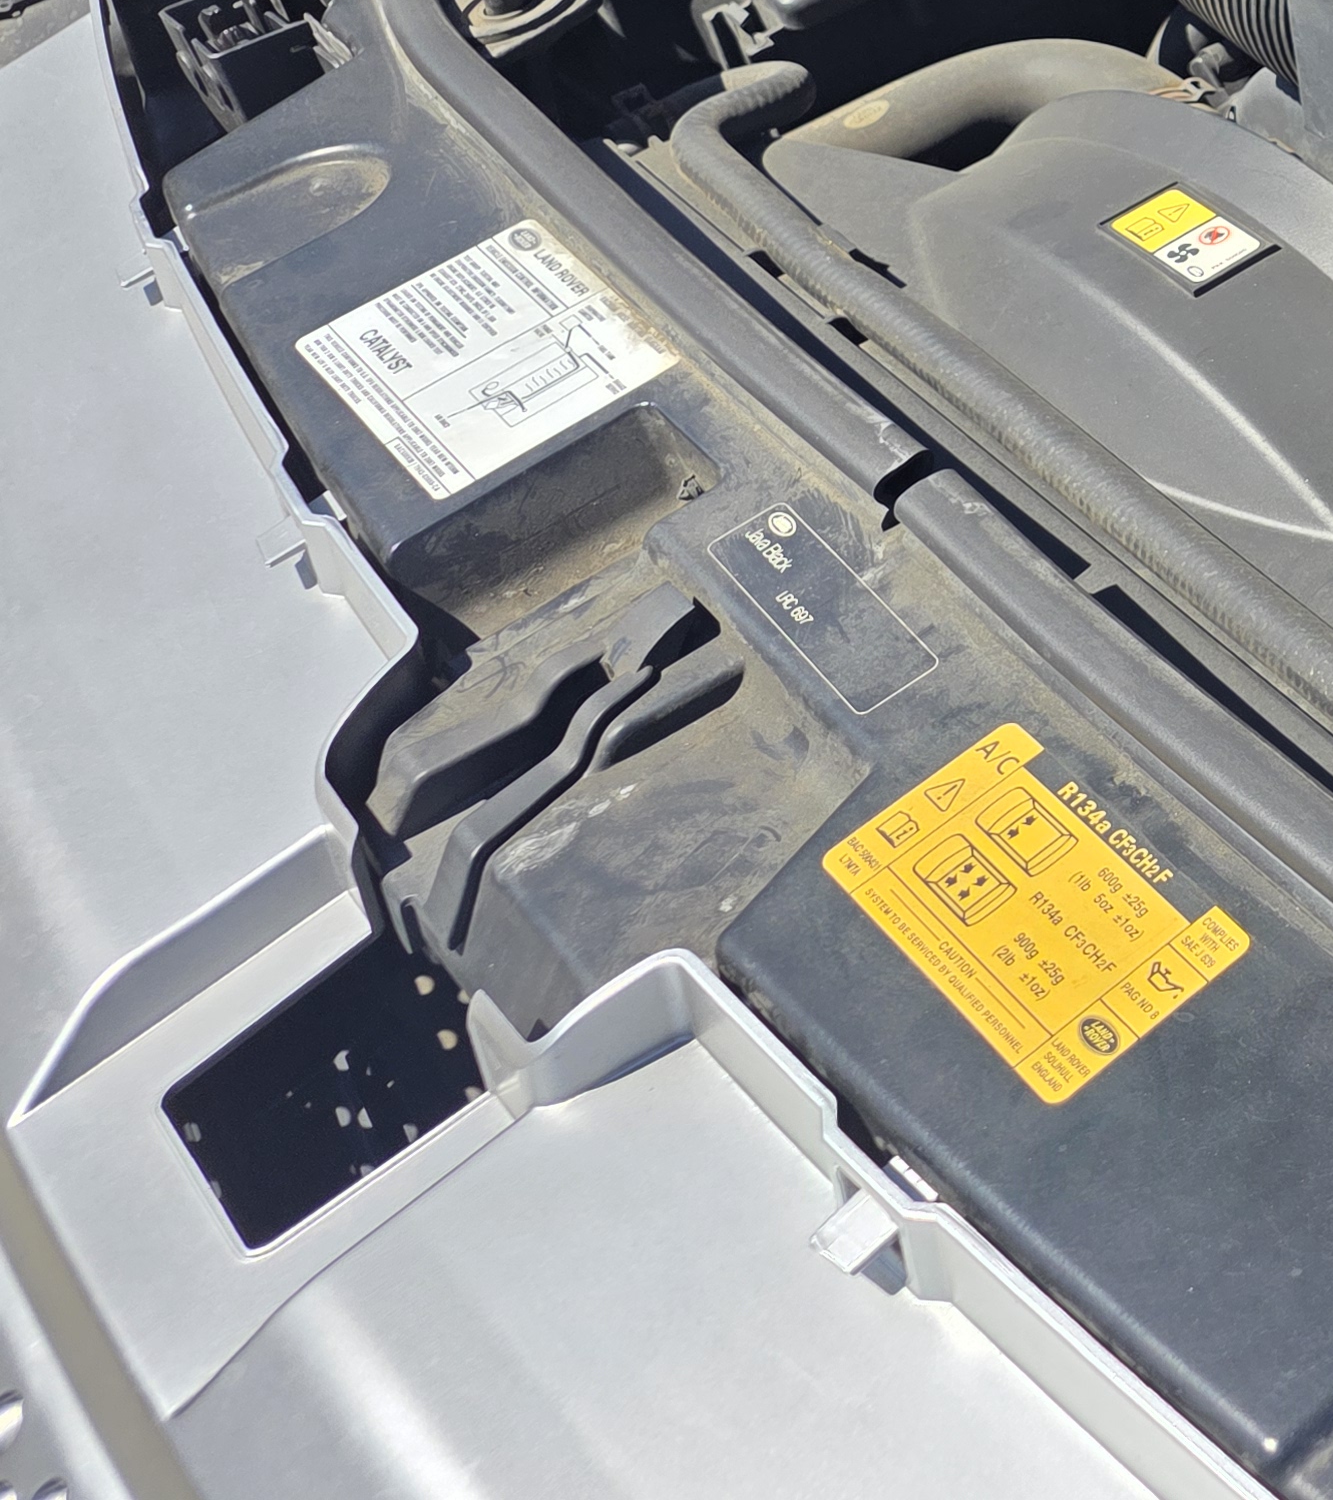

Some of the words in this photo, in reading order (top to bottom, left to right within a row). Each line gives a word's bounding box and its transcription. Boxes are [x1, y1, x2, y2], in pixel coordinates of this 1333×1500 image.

[532, 248, 564, 272] LAND
[554, 267, 590, 297] ROVER
[356, 327, 413, 376] CATALYST
[744, 528, 771, 551] Java
[762, 543, 792, 573] Black
[775, 590, 799, 611] LRC
[790, 604, 814, 625] 697
[974, 736, 1021, 775] A/C
[1057, 781, 1111, 833] R134a
[846, 836, 865, 852] BAC
[1027, 891, 1065, 926] R134a
[1066, 871, 1093, 894] (1lb
[1092, 893, 1115, 914] 5oz
[1108, 911, 1144, 943] ±1oz)
[1093, 867, 1125, 894] 600g
[1118, 890, 1150, 919] ±25g
[1179, 934, 1200, 952] SAE
[1199, 952, 1217, 968] 639
[1197, 932, 1220, 953] WITH
[1200, 916, 1240, 952] COMPLIES
[863, 887, 893, 915] SYSTEM
[887, 912, 902, 925] TO
[896, 921, 912, 935] BE
[906, 931, 942, 967] SERVICED
[937, 963, 952, 977] BY
[946, 974, 985, 1012] QUALIFIED
[979, 1009, 1025, 1054] PERSONNEL
[936, 940, 977, 979] CAUTION
[989, 943, 1018, 969] (2lb
[1015, 969, 1051, 1003] ±1oz)
[1009, 932, 1041, 961] 900g
[1034, 956, 1067, 986] ±25g
[1119, 981, 1142, 1002] PAG
[1135, 997, 1155, 1014] ND
[1148, 1010, 1160, 1020] 8
[1083, 1026, 1111, 1053] ROVER
[1090, 1019, 1113, 1041] LAND
[1030, 1060, 1063, 1093] ENGLAND
[1042, 1050, 1076, 1083] SOLIHULL
[1050, 1037, 1072, 1057] LAND
[1065, 1053, 1092, 1078] ROVER
